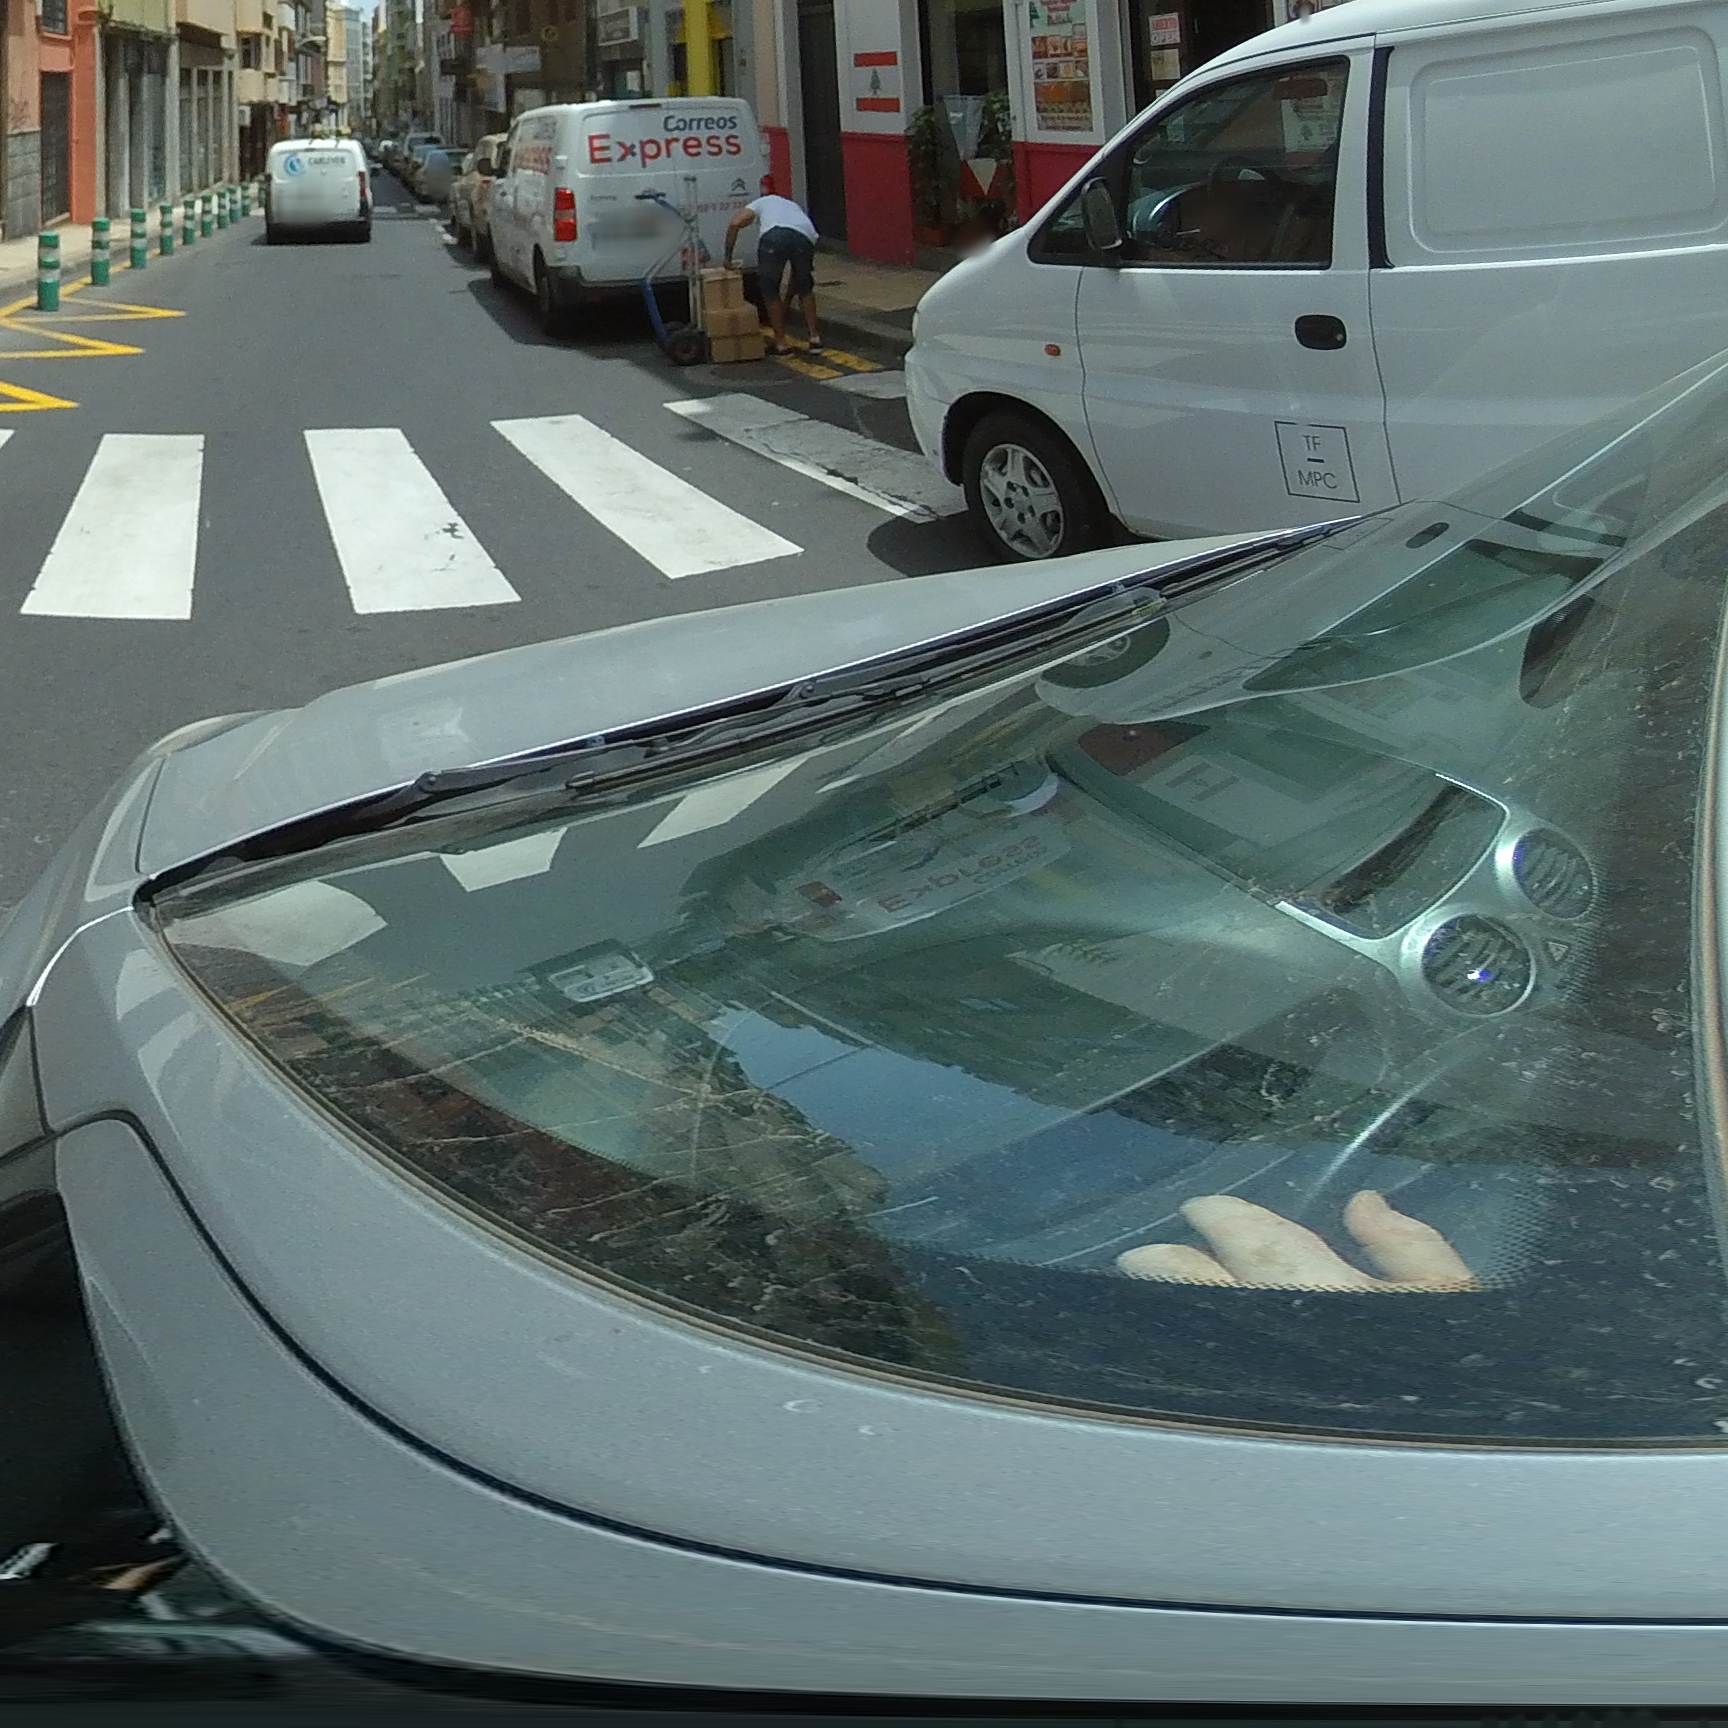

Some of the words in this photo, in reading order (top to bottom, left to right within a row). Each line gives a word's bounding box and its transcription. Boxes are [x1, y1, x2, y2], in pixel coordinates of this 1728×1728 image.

[663, 115, 738, 132] Correos
[588, 132, 742, 168] Express
[1303, 435, 1321, 451] TF
[1297, 469, 1338, 489] MPC
